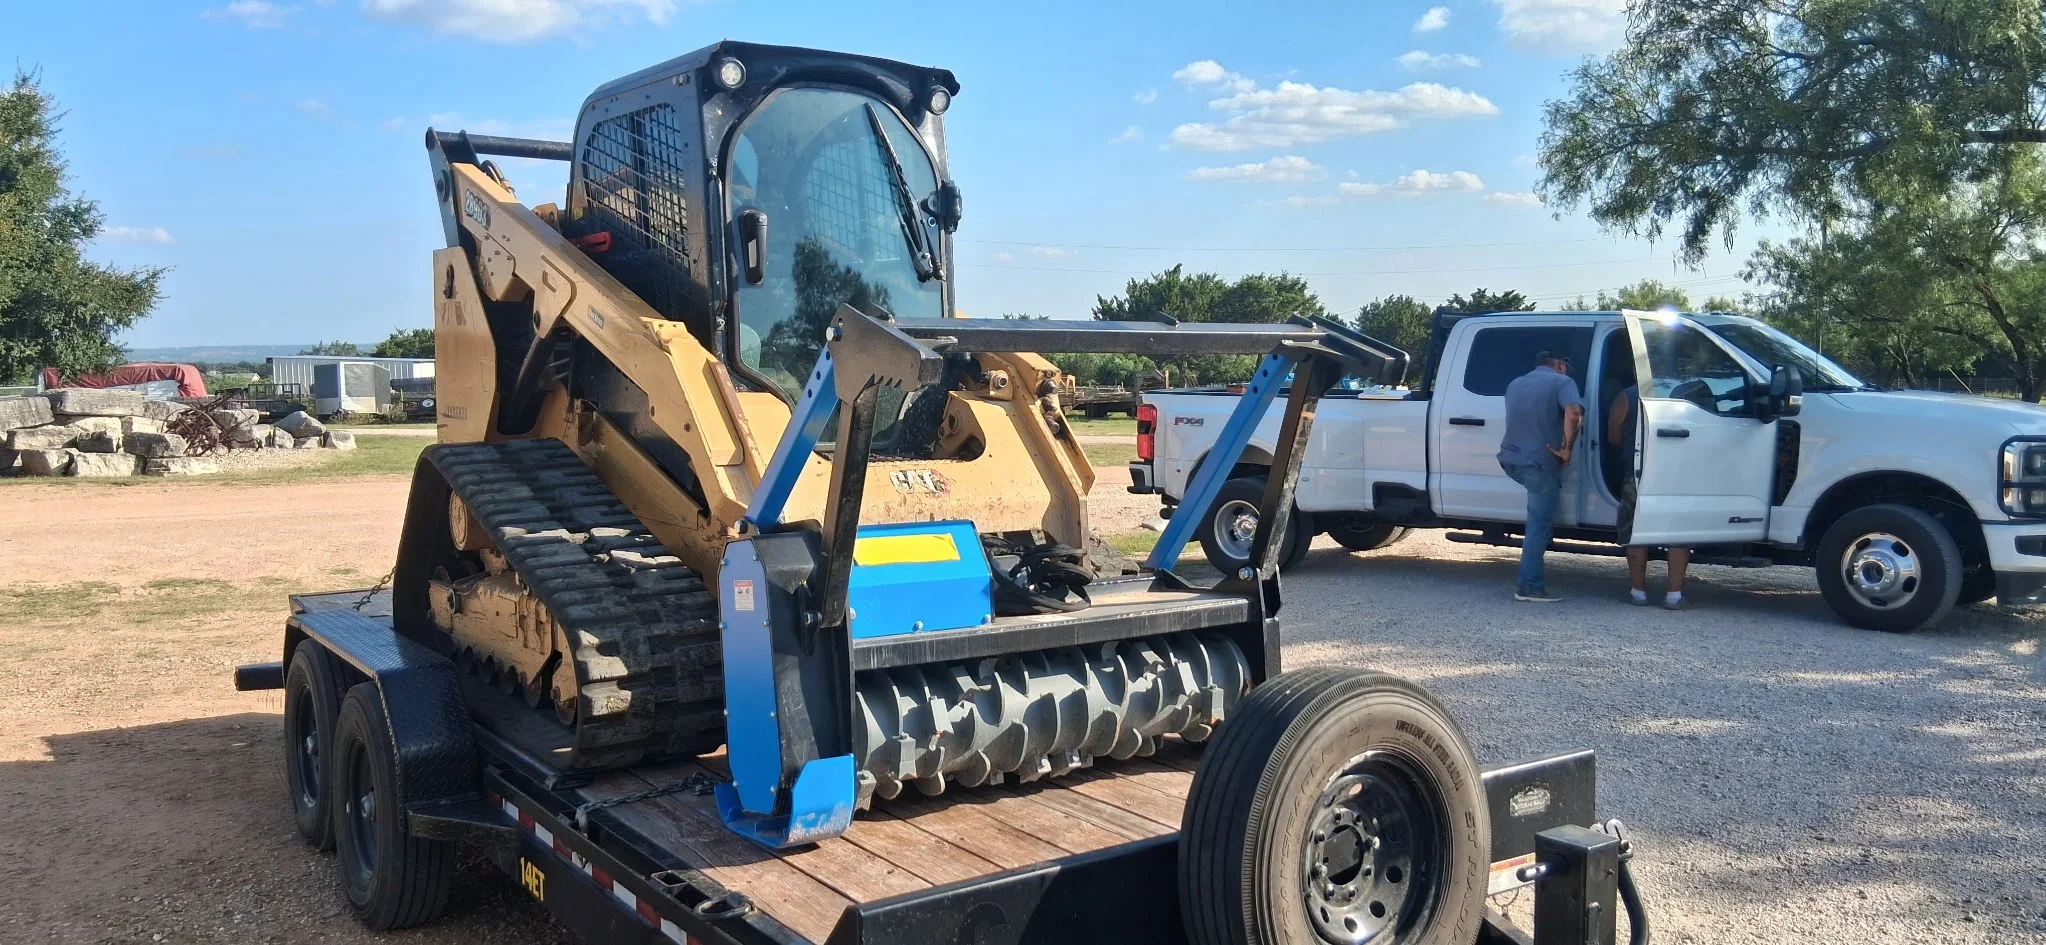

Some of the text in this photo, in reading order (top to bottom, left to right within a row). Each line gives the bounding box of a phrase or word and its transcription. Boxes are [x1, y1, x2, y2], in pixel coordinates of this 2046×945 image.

[1174, 416, 1204, 426] FX4
[889, 469, 939, 493] CAT
[1422, 733, 1436, 749] ALL
[520, 856, 545, 902] 14ET
